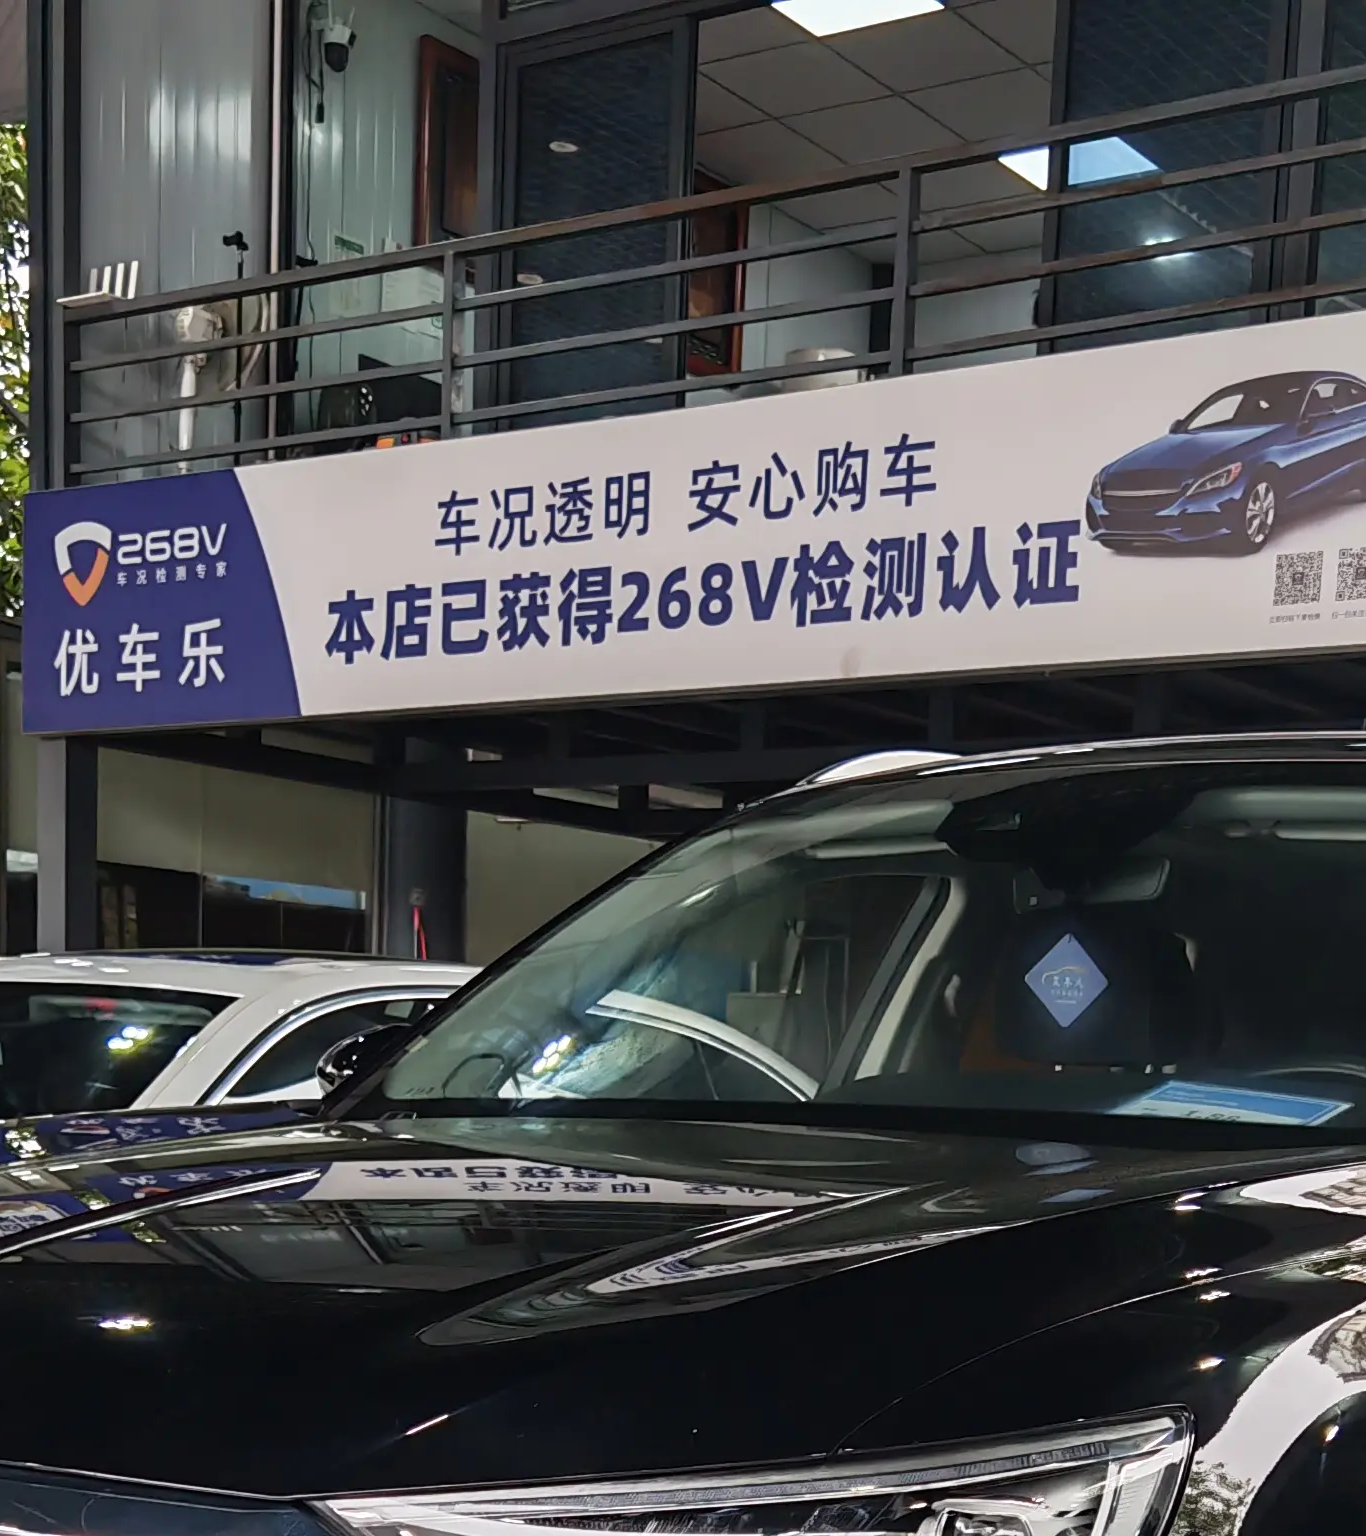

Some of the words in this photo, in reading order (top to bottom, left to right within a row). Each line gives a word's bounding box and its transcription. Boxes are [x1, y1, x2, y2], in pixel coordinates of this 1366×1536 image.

[434, 470, 651, 556] 车况透明
[687, 433, 938, 532] 安心购车
[115, 560, 228, 587] 车况检测专家
[116, 522, 228, 566] 268V
[324, 518, 1082, 665] 本店已获得268V检测认证
[53, 617, 227, 697] 优车乐
